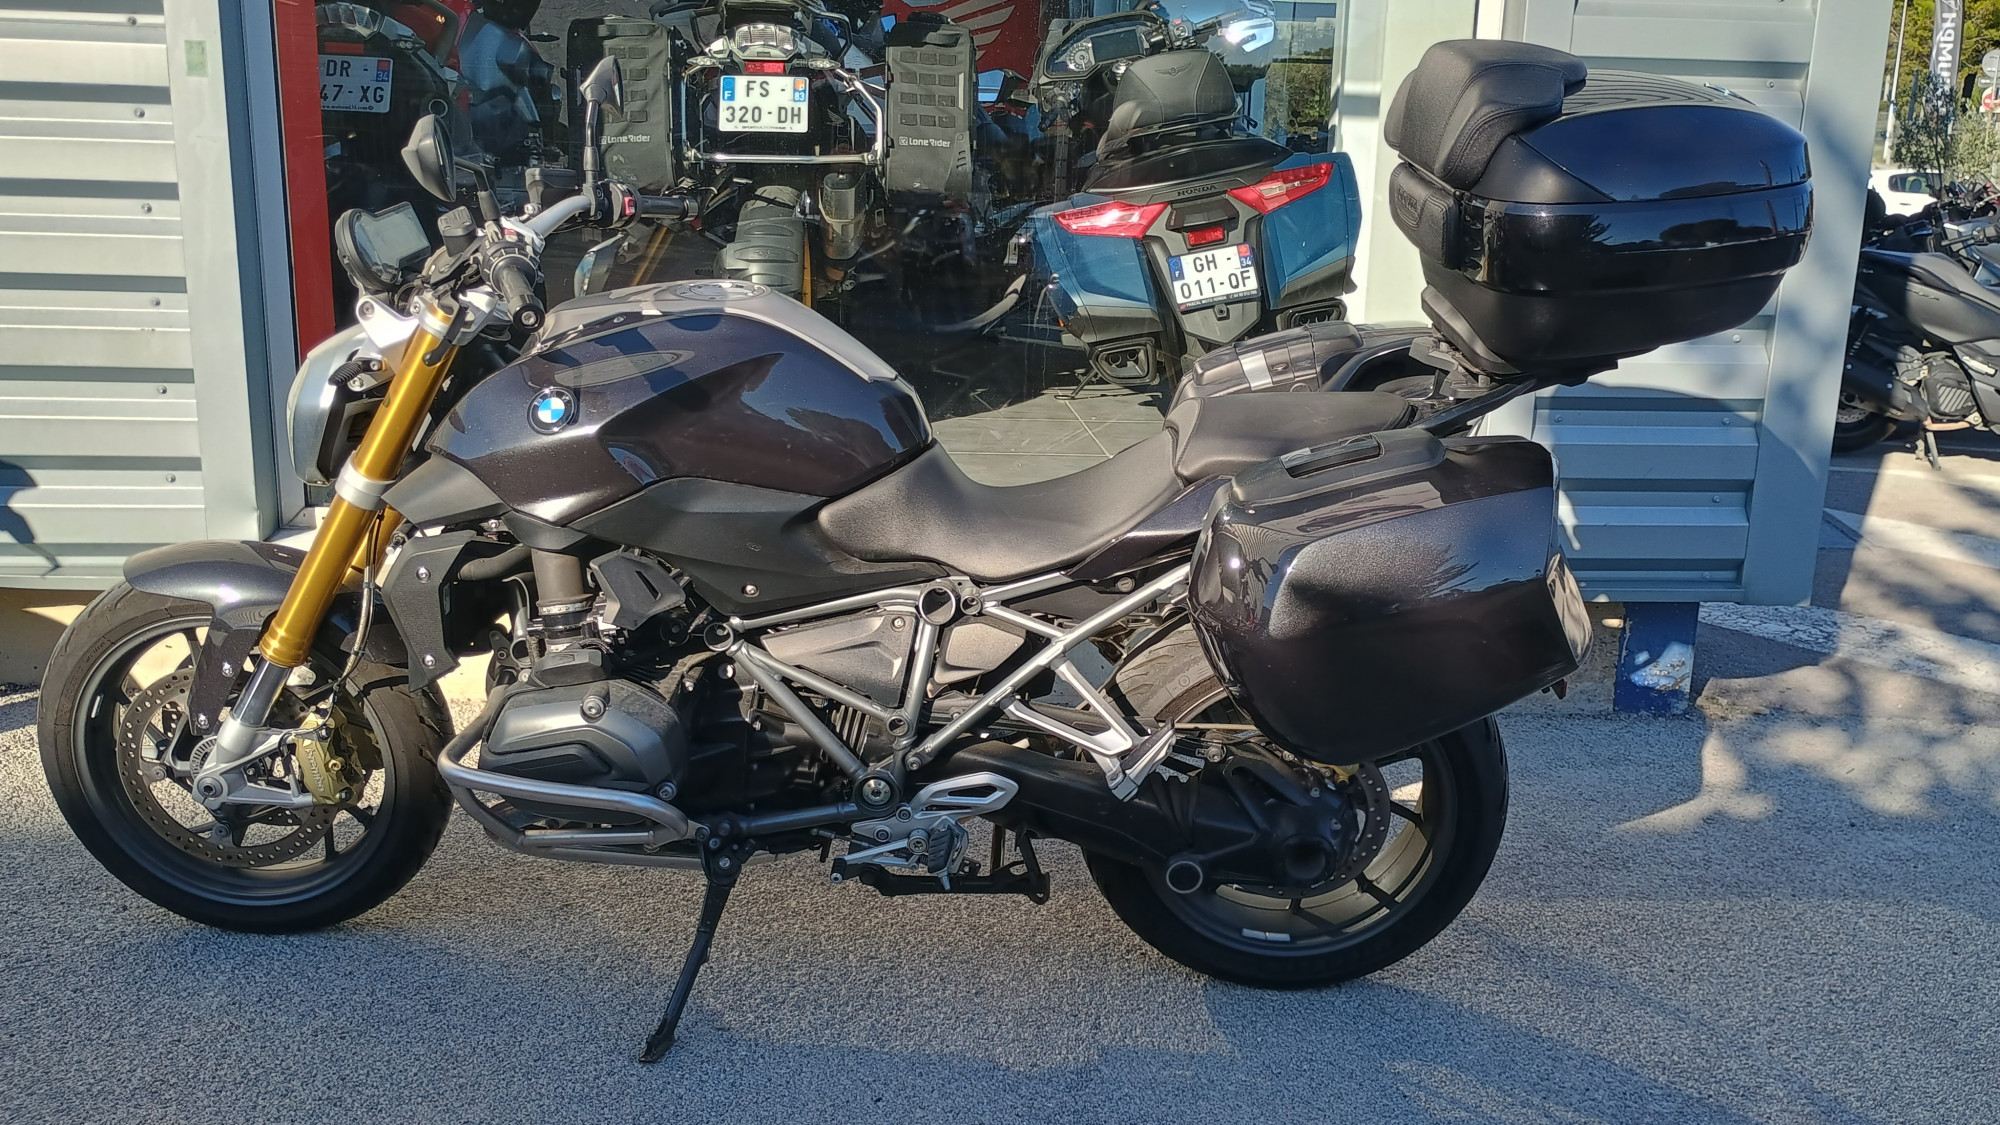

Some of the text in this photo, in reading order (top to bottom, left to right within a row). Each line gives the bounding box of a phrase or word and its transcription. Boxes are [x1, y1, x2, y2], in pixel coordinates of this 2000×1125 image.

[326, 59, 351, 77] DR
[377, 71, 389, 81] 34
[746, 80, 770, 97] FS
[724, 91, 732, 100] F
[794, 92, 805, 101] 83
[726, 106, 801, 124] 320-DH
[1177, 184, 1218, 197] HONDA
[1193, 253, 1218, 273] GH
[1240, 257, 1252, 266] 34
